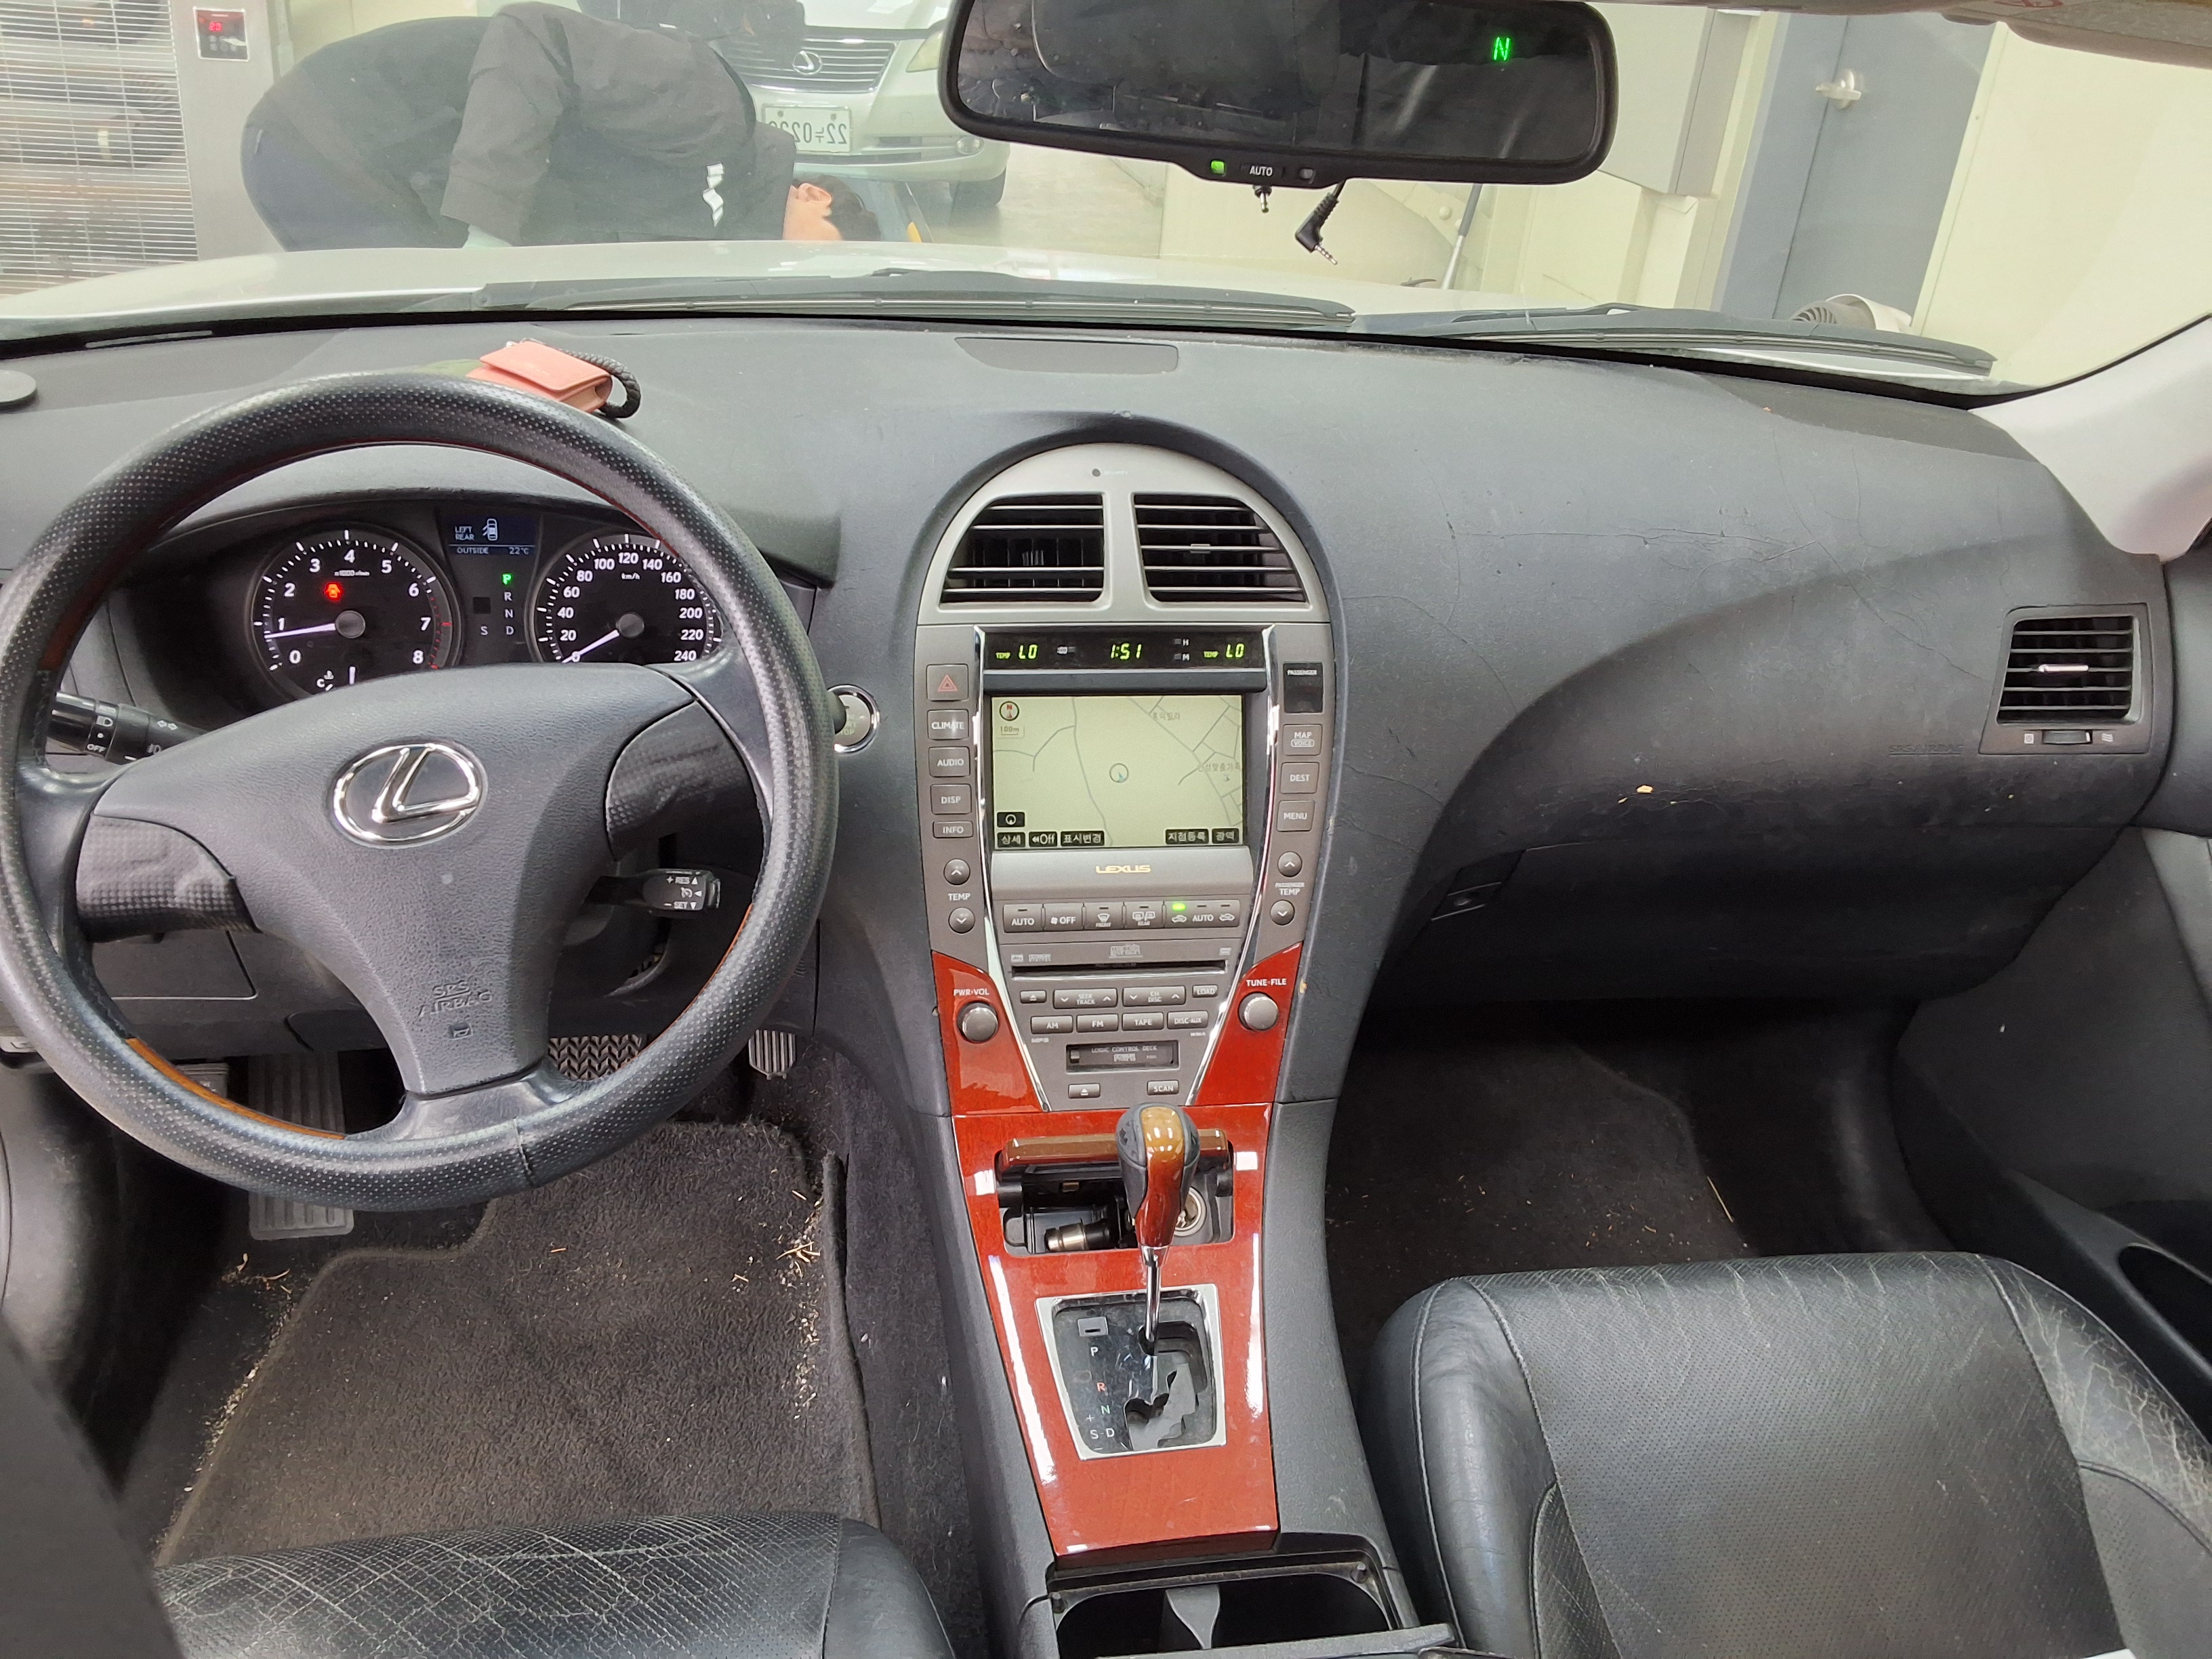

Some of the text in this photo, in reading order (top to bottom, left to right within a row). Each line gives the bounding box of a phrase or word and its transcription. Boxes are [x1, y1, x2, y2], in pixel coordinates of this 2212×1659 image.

[1493, 37, 1510, 61] N
[1250, 165, 1273, 176] AUTO
[344, 549, 356, 563] 4
[618, 552, 639, 565] 120
[309, 558, 321, 573] 3
[381, 560, 393, 574] 5
[594, 558, 615, 571] 100
[642, 559, 663, 571] 140
[502, 573, 512, 585] P
[576, 571, 593, 582] 80
[661, 572, 682, 583] 160
[284, 583, 296, 597] 2
[408, 583, 420, 597] 6
[563, 586, 580, 598] 60
[675, 588, 695, 600] 180
[504, 592, 512, 601] R
[505, 609, 514, 619] N
[557, 607, 574, 619] 40
[679, 608, 703, 619] 200
[278, 617, 285, 630] 1
[420, 617, 431, 631] 7
[480, 626, 489, 636] S
[506, 626, 514, 635] D
[560, 630, 577, 642] 20
[681, 629, 704, 640] 220
[674, 651, 697, 661] 240
[1110, 642, 1142, 660] 1:51
[289, 650, 302, 664] 0
[412, 650, 424, 664] 8
[931, 722, 964, 730] CLIMATE
[87, 743, 106, 753] OFF
[937, 758, 964, 766] AUDIO
[1040, 834, 1055, 844] Off
[1095, 865, 1151, 874] LEXUS
[948, 893, 970, 901] TEMP
[1011, 918, 1035, 926] AUTO
[1059, 917, 1076, 925] OFF
[1192, 914, 1214, 922] AUTO
[1090, 1347, 1099, 1357] P
[1097, 1382, 1106, 1392] R
[1101, 1405, 1111, 1414] N
